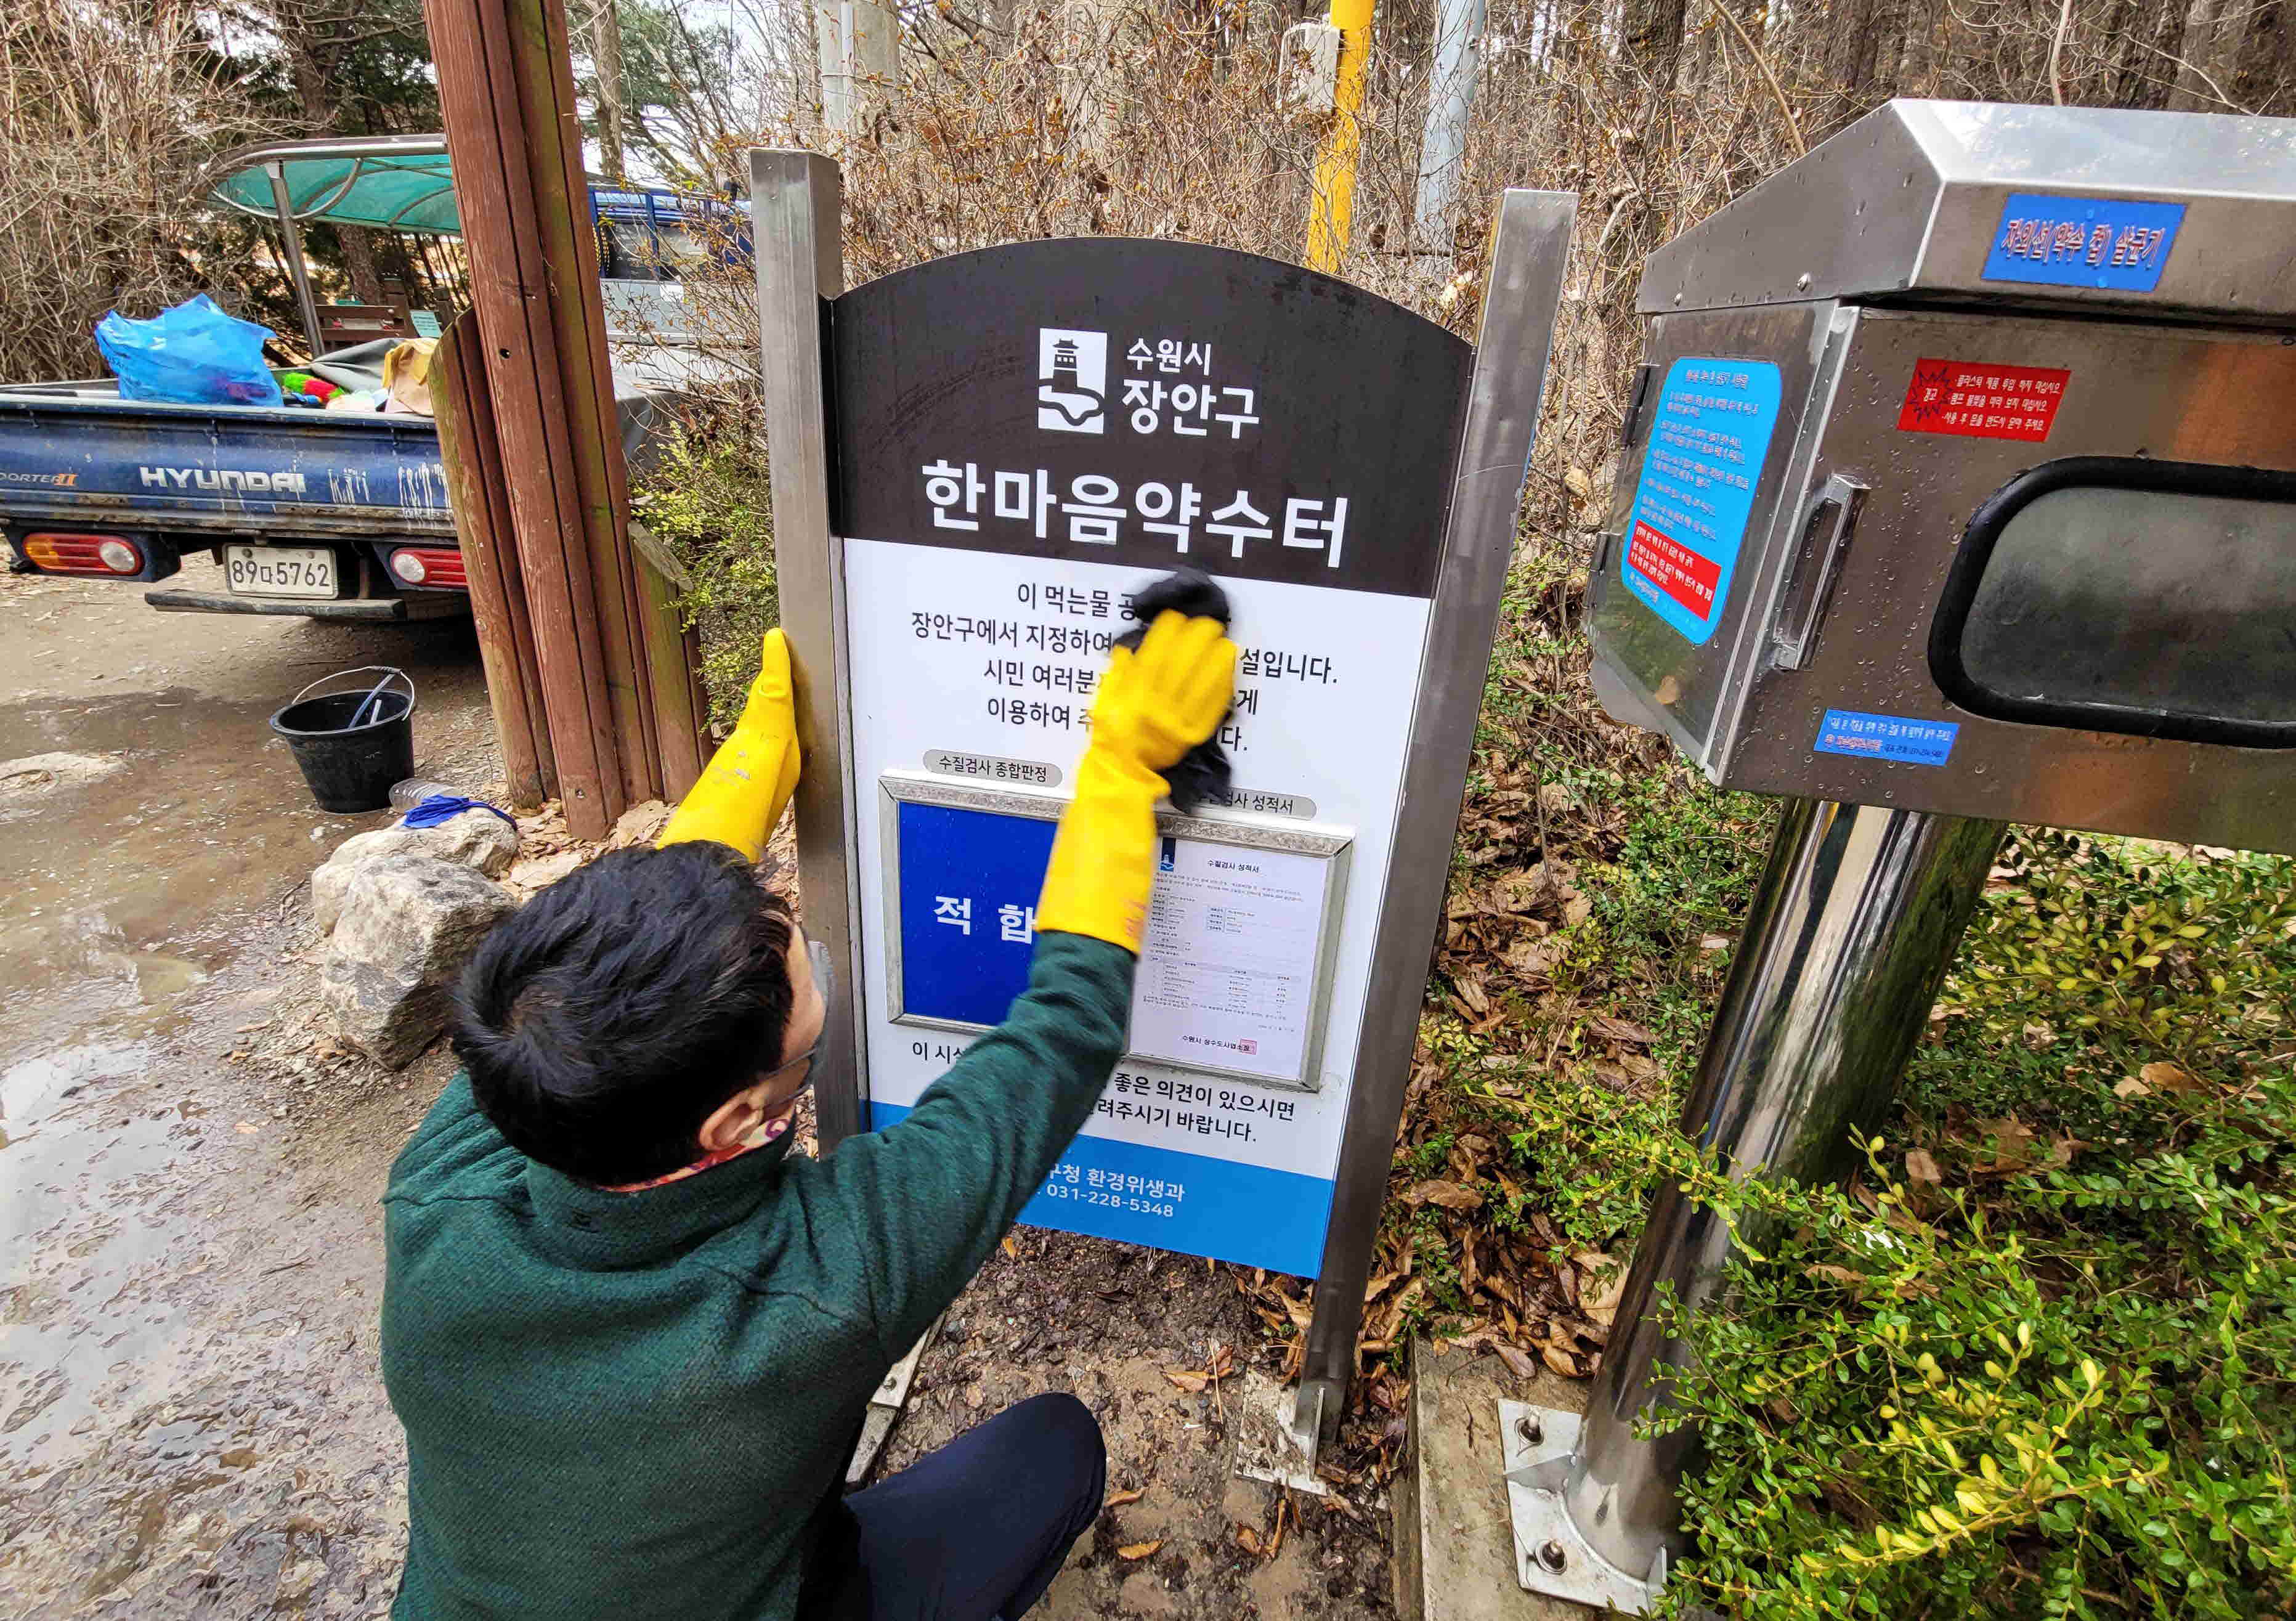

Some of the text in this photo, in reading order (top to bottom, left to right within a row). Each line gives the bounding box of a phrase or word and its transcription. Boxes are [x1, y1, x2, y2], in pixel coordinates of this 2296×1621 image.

[2110, 225, 2166, 270] 살균기
[1126, 338, 1211, 376] 수원시
[1122, 378, 1260, 439] 장안구
[139, 466, 306, 493] HYUNDAI
[921, 458, 1348, 569] 한마음약수터
[1018, 582, 1036, 610] 이
[1045, 585, 1111, 618] 먹는물
[912, 612, 1018, 648] 장안구에서
[1026, 624, 1113, 656] 지정하여
[984, 659, 1023, 687] 시민
[988, 697, 1070, 730] 이용하여
[938, 755, 1047, 783] 수질검사 종합판정
[1252, 795, 1294, 815] 성적서
[1207, 859, 1260, 874] 수질검사 성적서
[932, 893, 972, 936] 적
[912, 1041, 928, 1062] 이
[1182, 1034, 1202, 1045] 수원시
[1114, 1072, 1296, 1122] 좋은 의견이 있으시면
[1176, 1112, 1257, 1143] 바랍니다.
[1047, 1183, 1174, 1217] 031-228-5348
[1086, 1168, 1185, 1202] 환경위생과
